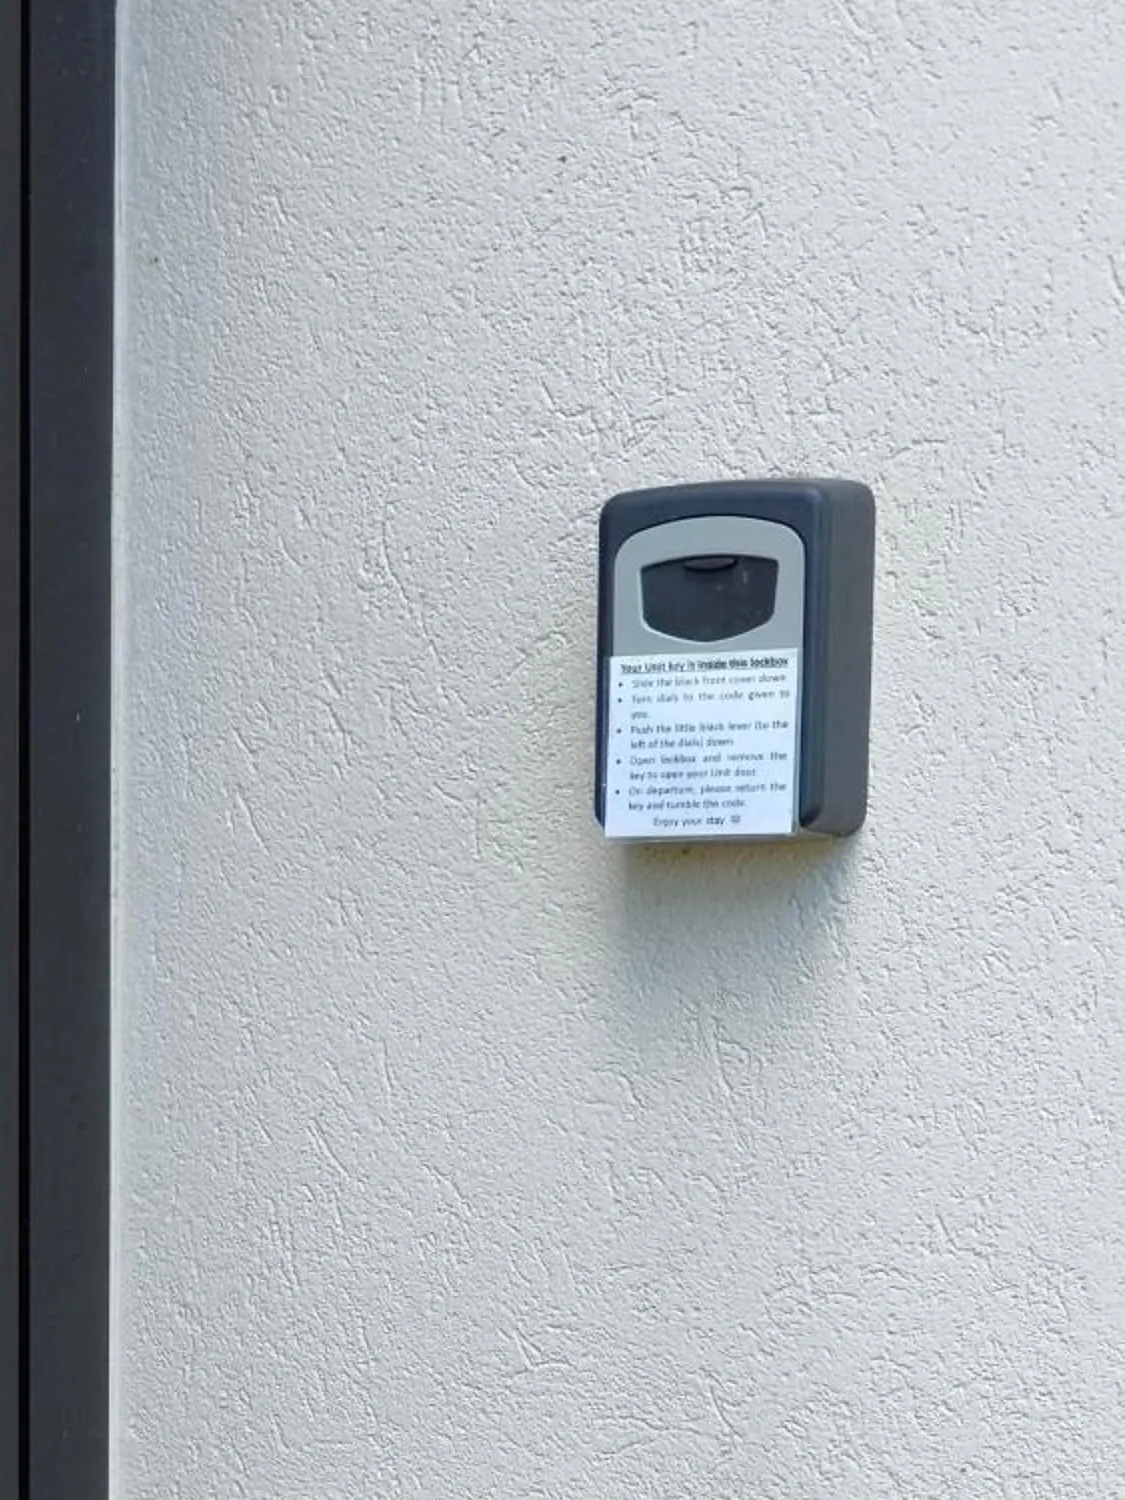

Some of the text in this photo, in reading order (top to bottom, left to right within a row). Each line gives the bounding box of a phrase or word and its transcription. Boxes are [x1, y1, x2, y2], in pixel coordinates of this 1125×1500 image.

[621, 657, 788, 673] Your Unit key is inside this lockbox
[657, 678, 672, 686] the
[703, 676, 724, 684] front
[632, 695, 652, 703] Turn
[748, 691, 774, 700] given
[780, 690, 789, 698] to
[631, 725, 653, 733] Push
[675, 723, 696, 732] little
[772, 720, 788, 728] the
[648, 740, 657, 748] of
[660, 739, 675, 747] the
[630, 756, 655, 765] Open
[661, 755, 696, 763] lockbox
[703, 753, 721, 762] and
[771, 752, 787, 760] the
[630, 772, 645, 781] key
[700, 785, 731, 795] please
[770, 783, 786, 791] the
[629, 802, 643, 811] key
[646, 801, 663, 810] and
[703, 799, 719, 808] the
[653, 817, 678, 827] Enjoy
[682, 817, 701, 826] your
